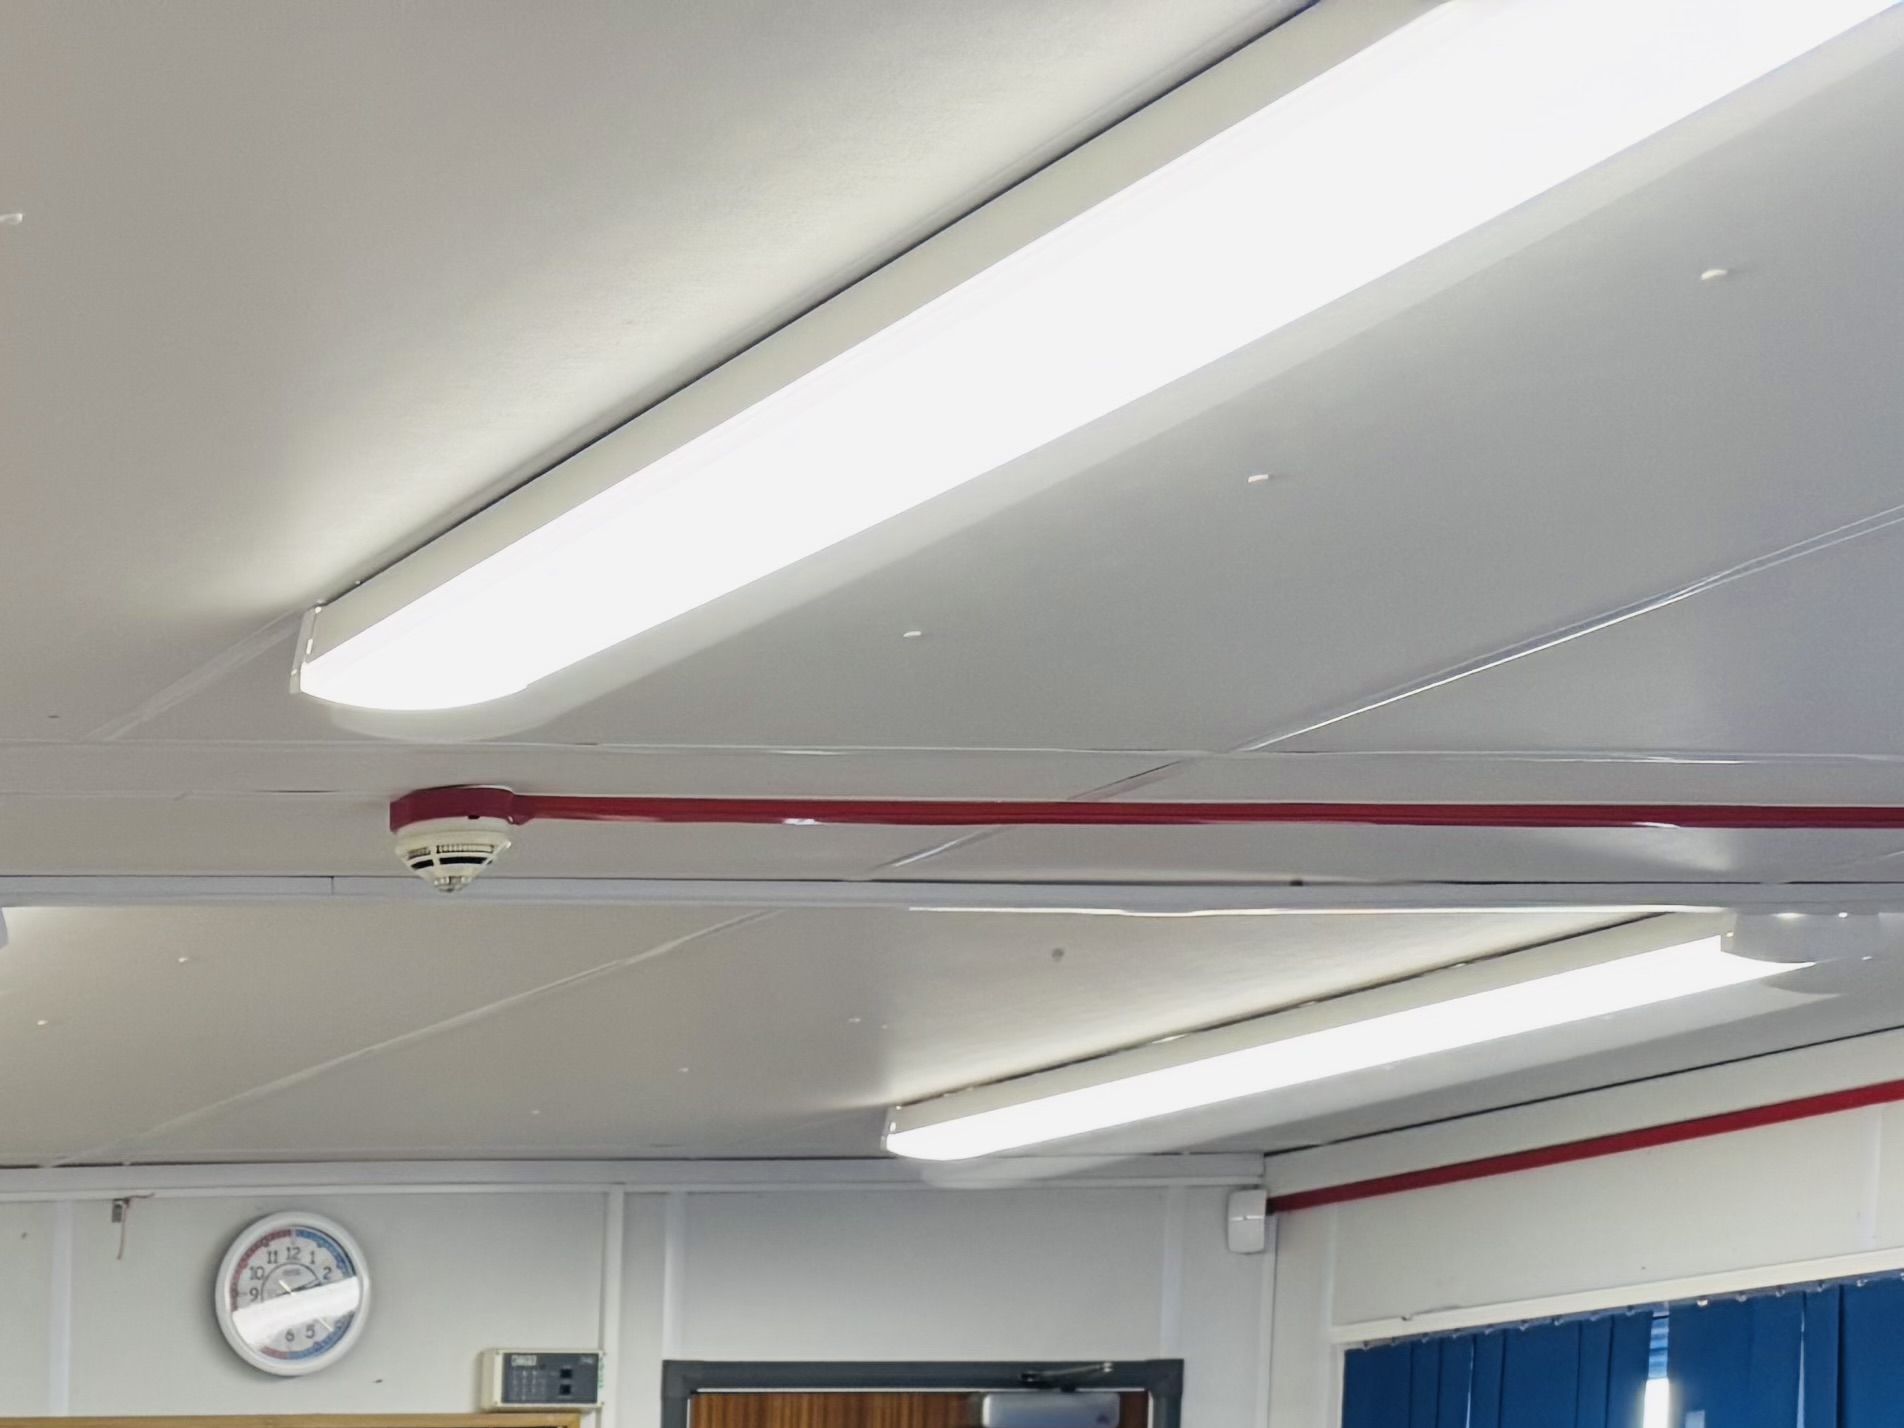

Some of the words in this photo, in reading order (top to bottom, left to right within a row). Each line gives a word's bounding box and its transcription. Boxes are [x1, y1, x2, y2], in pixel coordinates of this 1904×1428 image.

[266, 1250, 279, 1264] 11
[286, 1247, 301, 1261] 12
[309, 1250, 316, 1265] 1
[249, 1266, 265, 1280] 10
[322, 1266, 332, 1280] 2
[249, 1287, 259, 1302] 9
[285, 1328, 295, 1342] 6
[305, 1323, 316, 1339] 5
